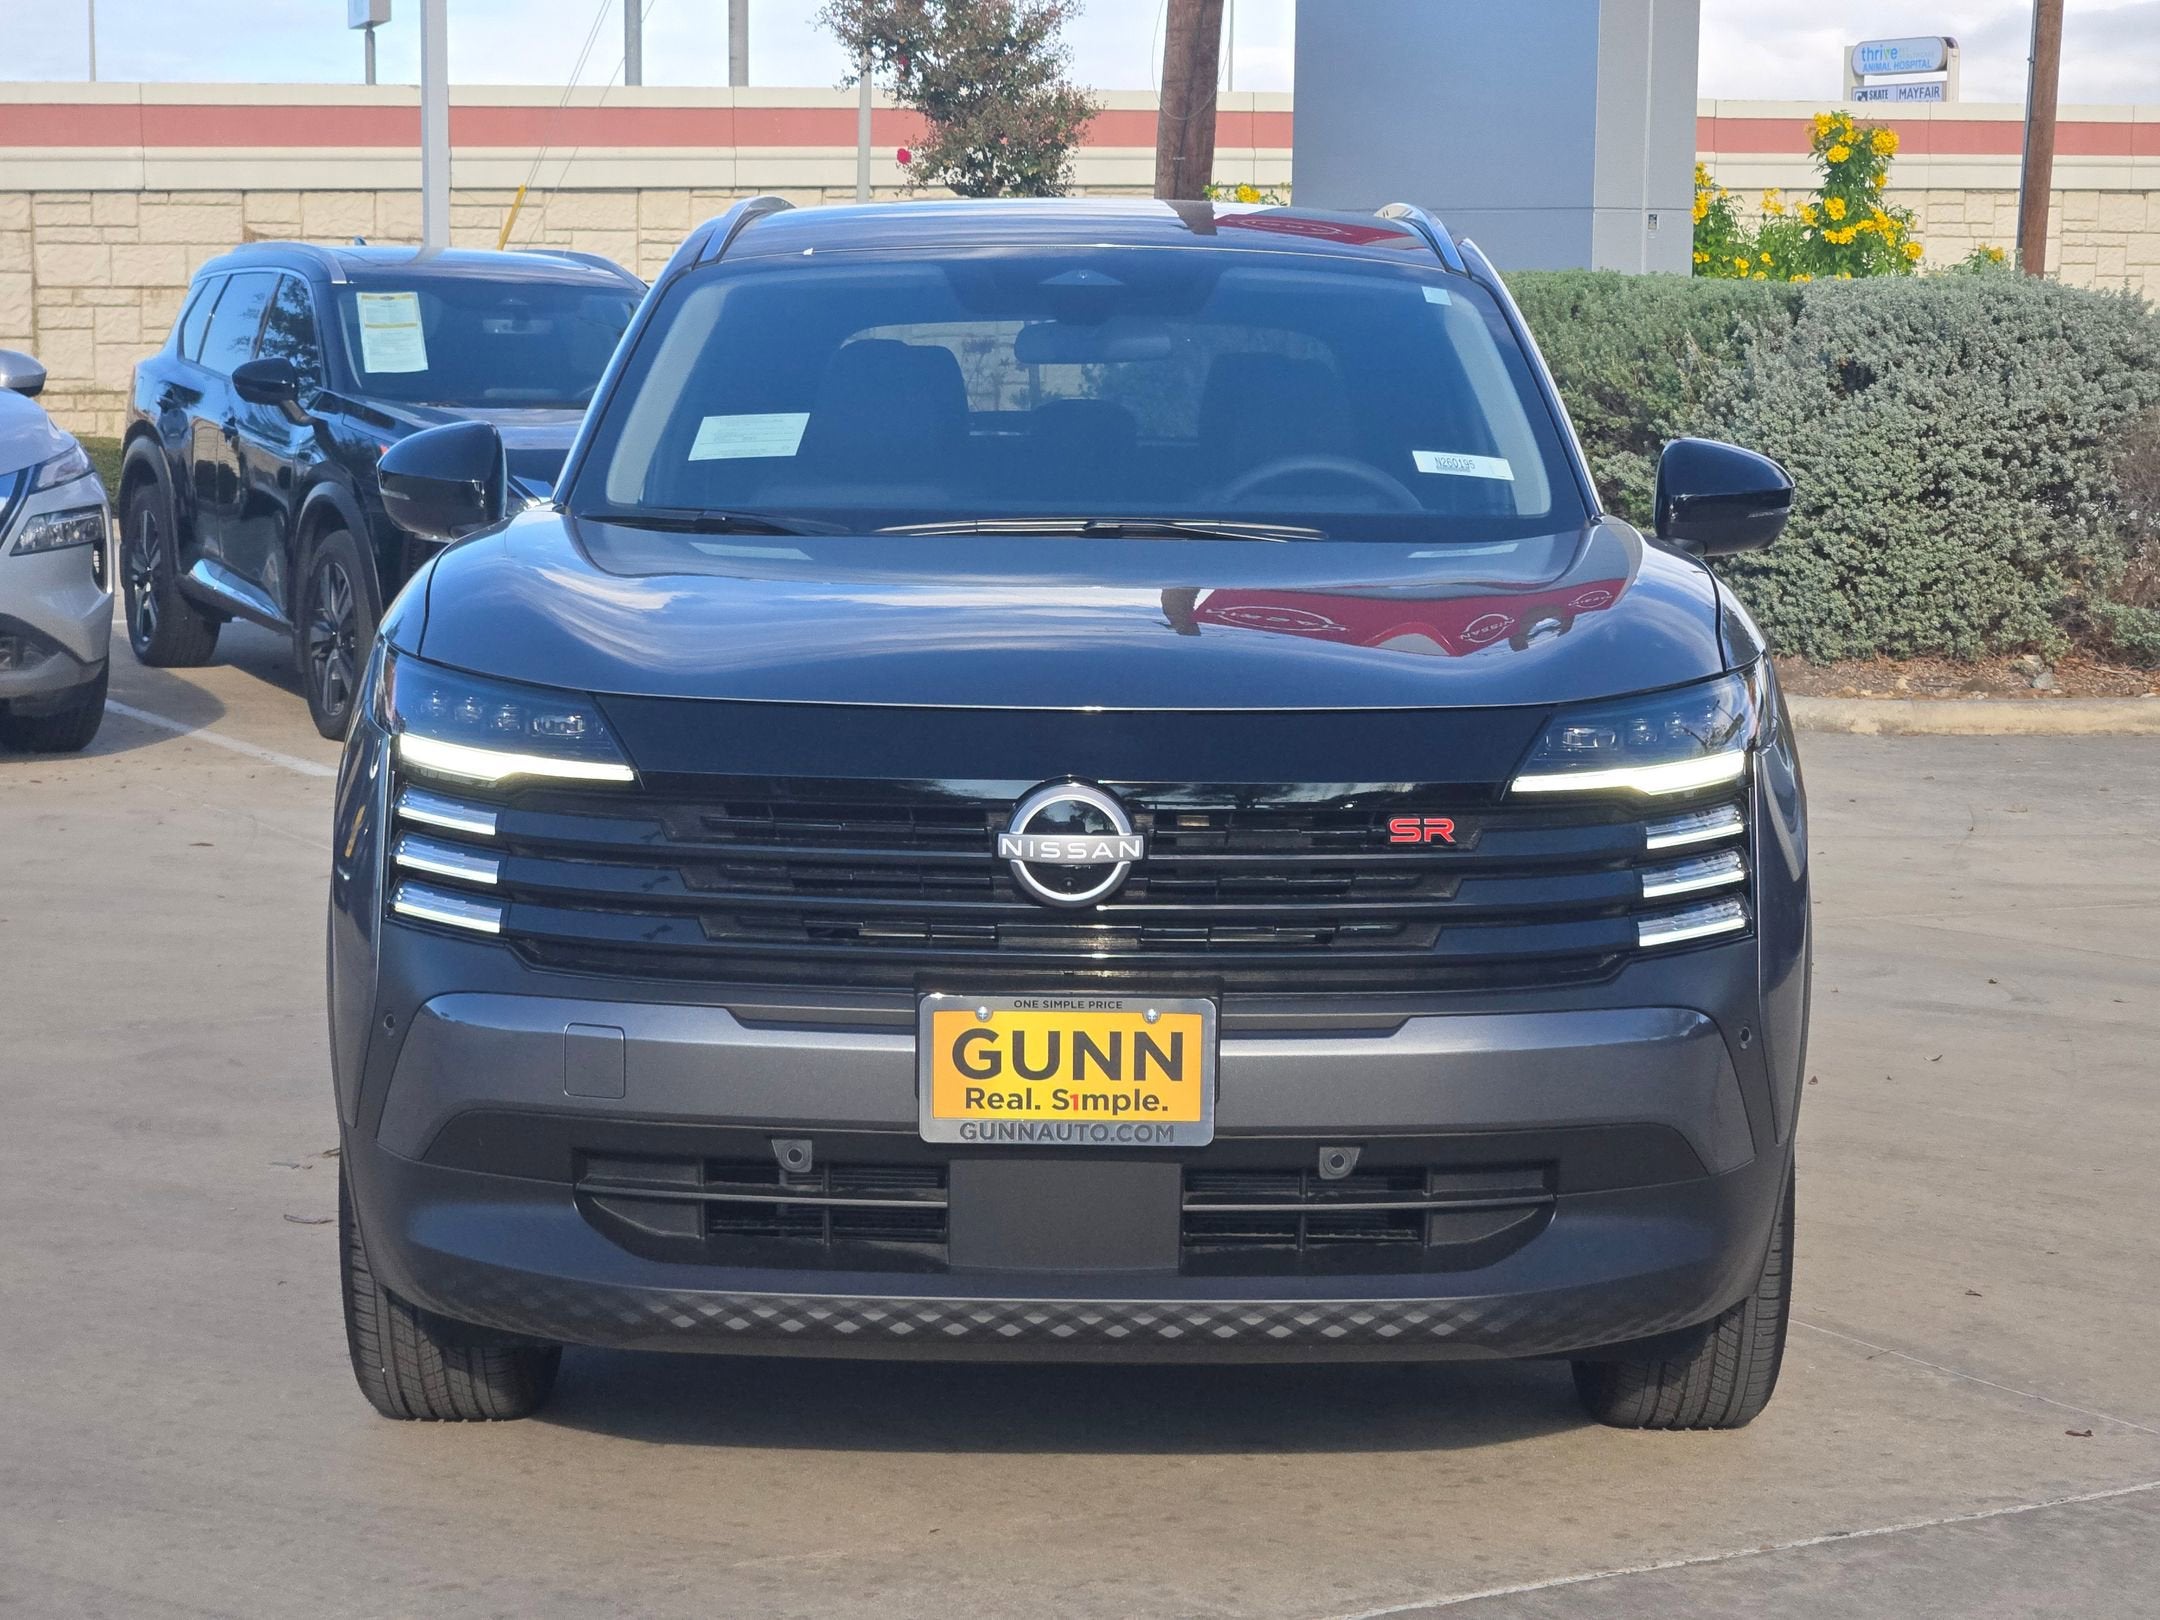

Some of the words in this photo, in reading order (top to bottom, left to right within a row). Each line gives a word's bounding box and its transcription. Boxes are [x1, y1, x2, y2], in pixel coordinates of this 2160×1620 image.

[1861, 44, 1898, 61] thrive
[1862, 61, 1891, 73] ANIMAL
[1893, 59, 1932, 70] HOSPITAL
[1869, 89, 1889, 100] SKATE
[1899, 86, 1940, 100] MAYFAIR
[1389, 818, 1456, 843] SR
[1001, 838, 1140, 859] NISSAN
[1013, 1000, 1039, 1009] ONE
[1042, 1000, 1085, 1009] SIMPLE
[1088, 1000, 1123, 1010] PRICE
[952, 1027, 1184, 1082] GUNN
[965, 1087, 1041, 1111] Real.
[959, 1121, 1175, 1144] GUNNAUTO.COM
